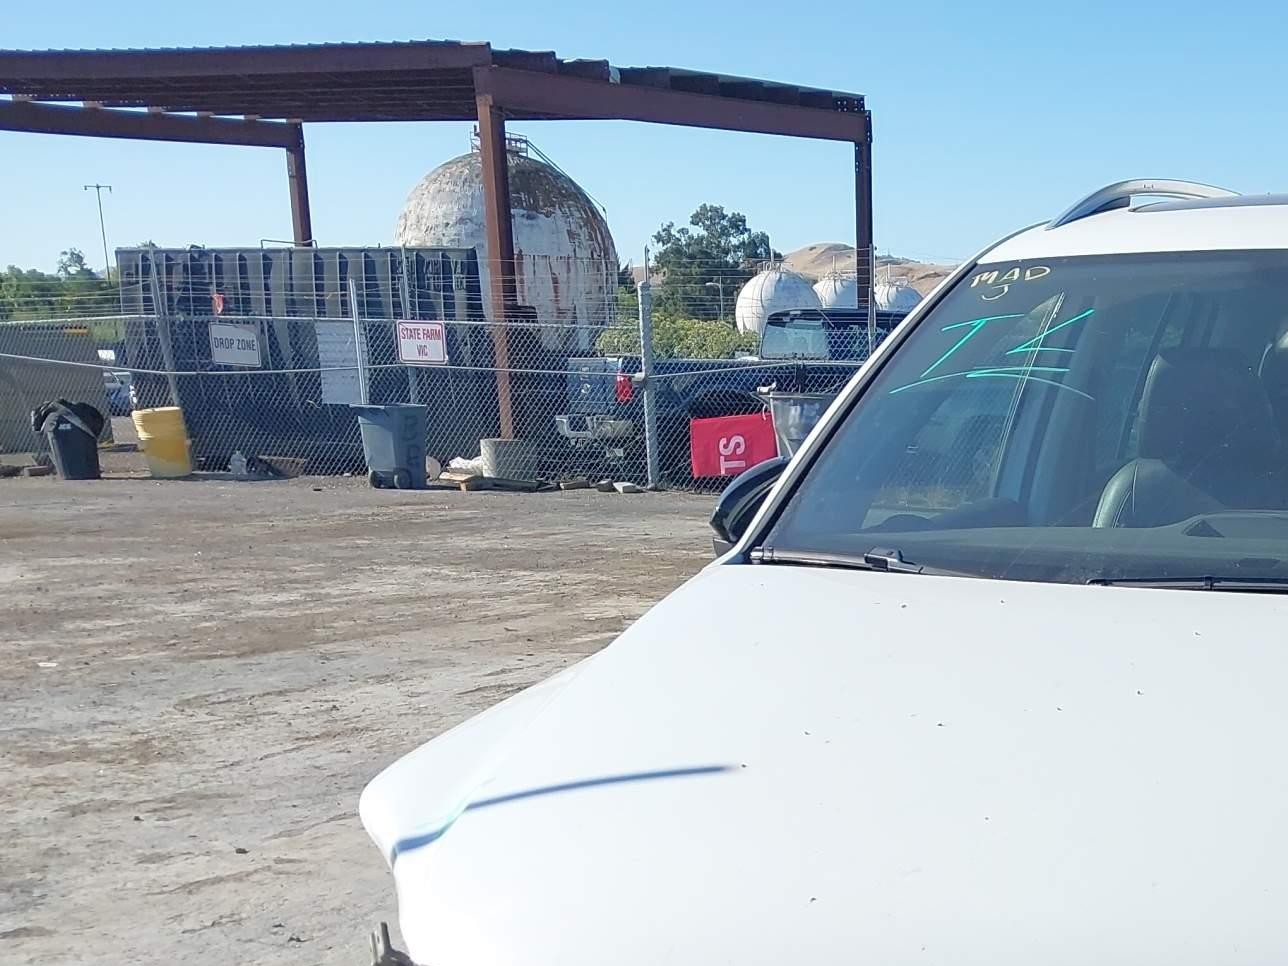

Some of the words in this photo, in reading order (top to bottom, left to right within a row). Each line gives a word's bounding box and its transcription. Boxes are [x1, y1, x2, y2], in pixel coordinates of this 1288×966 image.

[400, 327, 422, 340] STATE
[422, 328, 441, 341] FARM
[213, 336, 235, 350] DROP
[237, 338, 257, 351] ZONE
